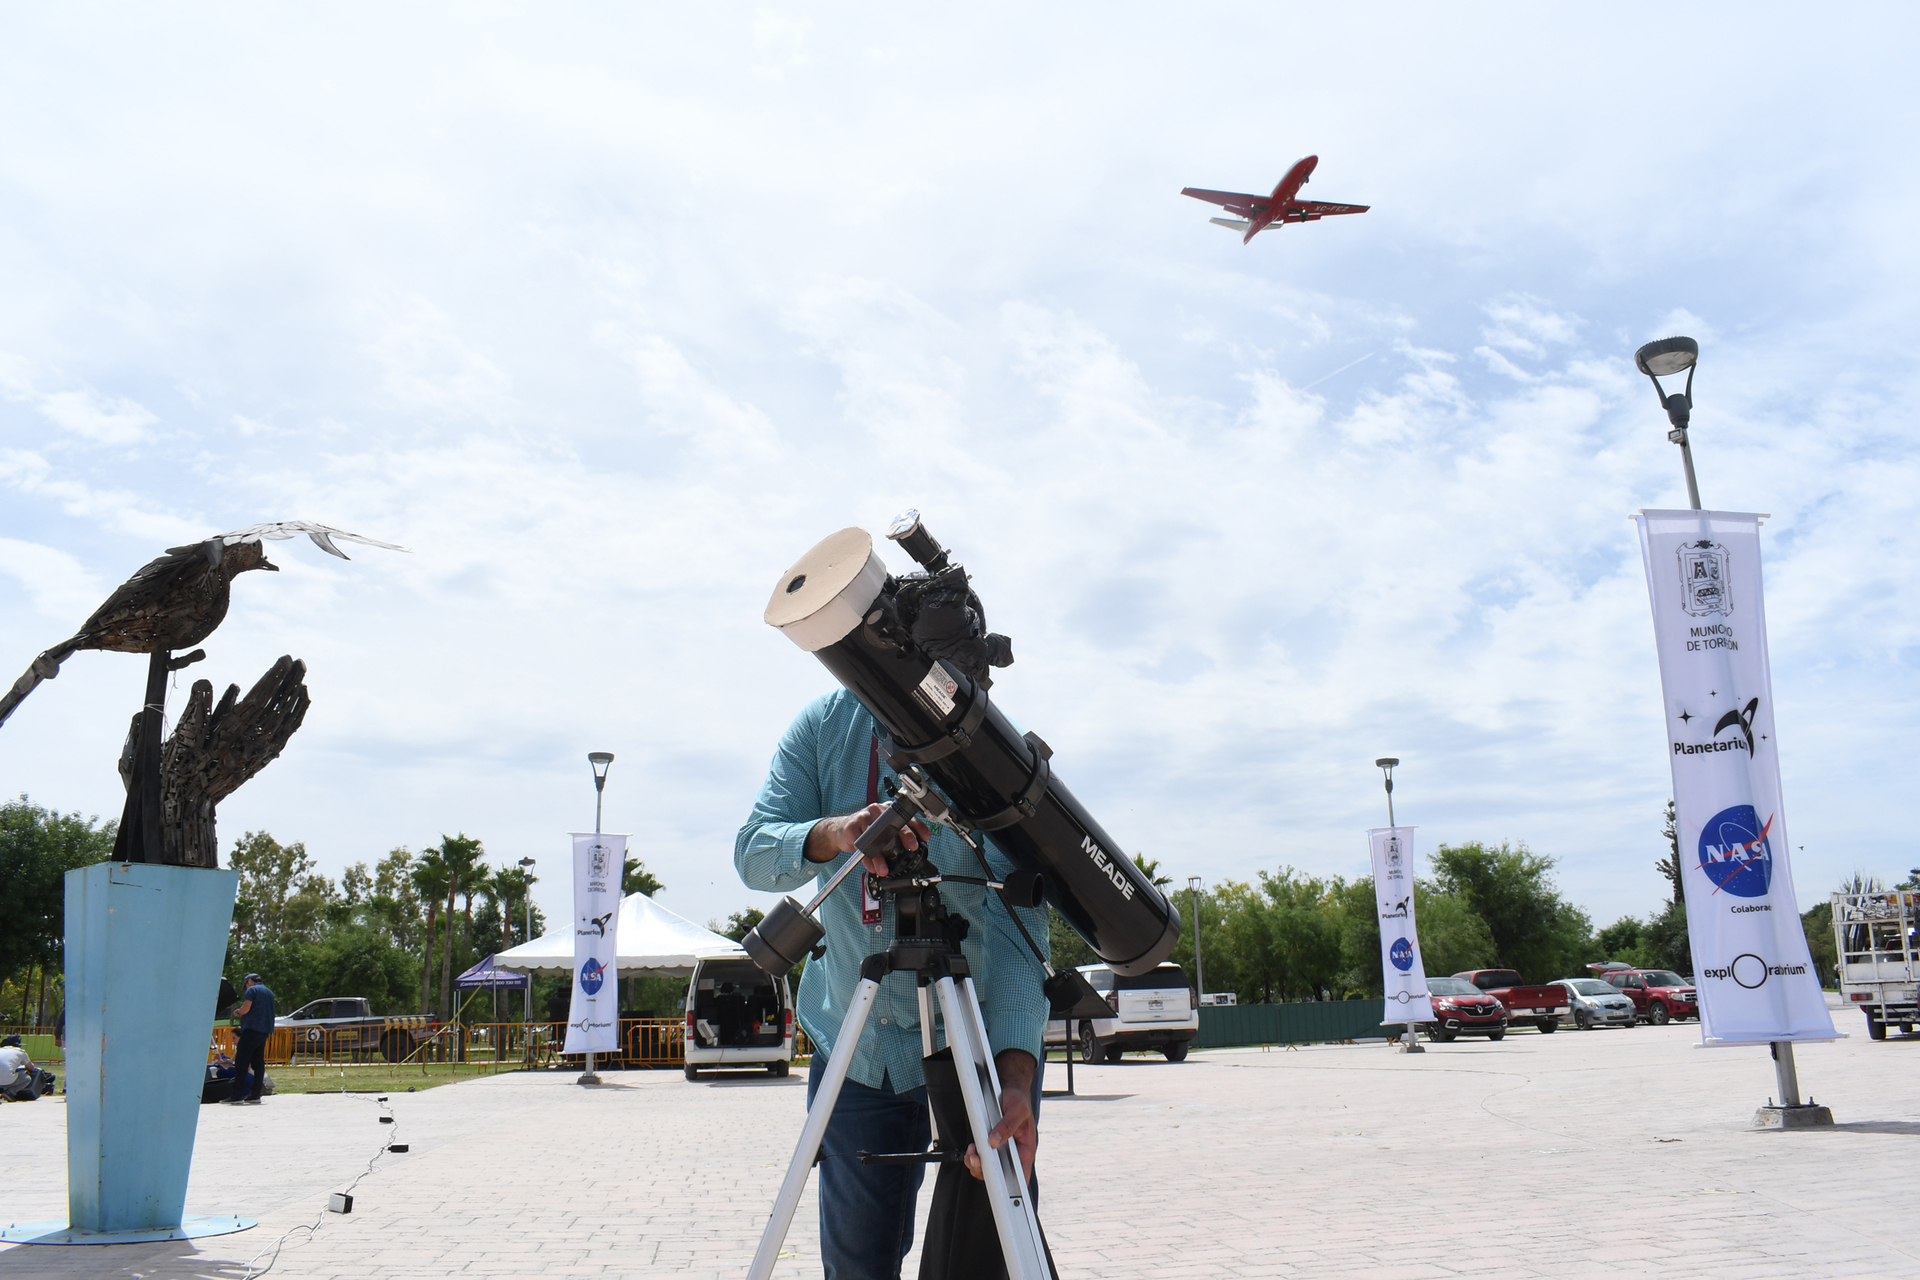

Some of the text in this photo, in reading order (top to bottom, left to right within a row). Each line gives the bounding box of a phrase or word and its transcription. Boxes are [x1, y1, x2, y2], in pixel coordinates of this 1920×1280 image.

[1686, 640, 1701, 652] DE
[1705, 841, 1770, 864] NASA
[1081, 834, 1135, 901] MEADE
[307, 1028, 318, 1042] 6
